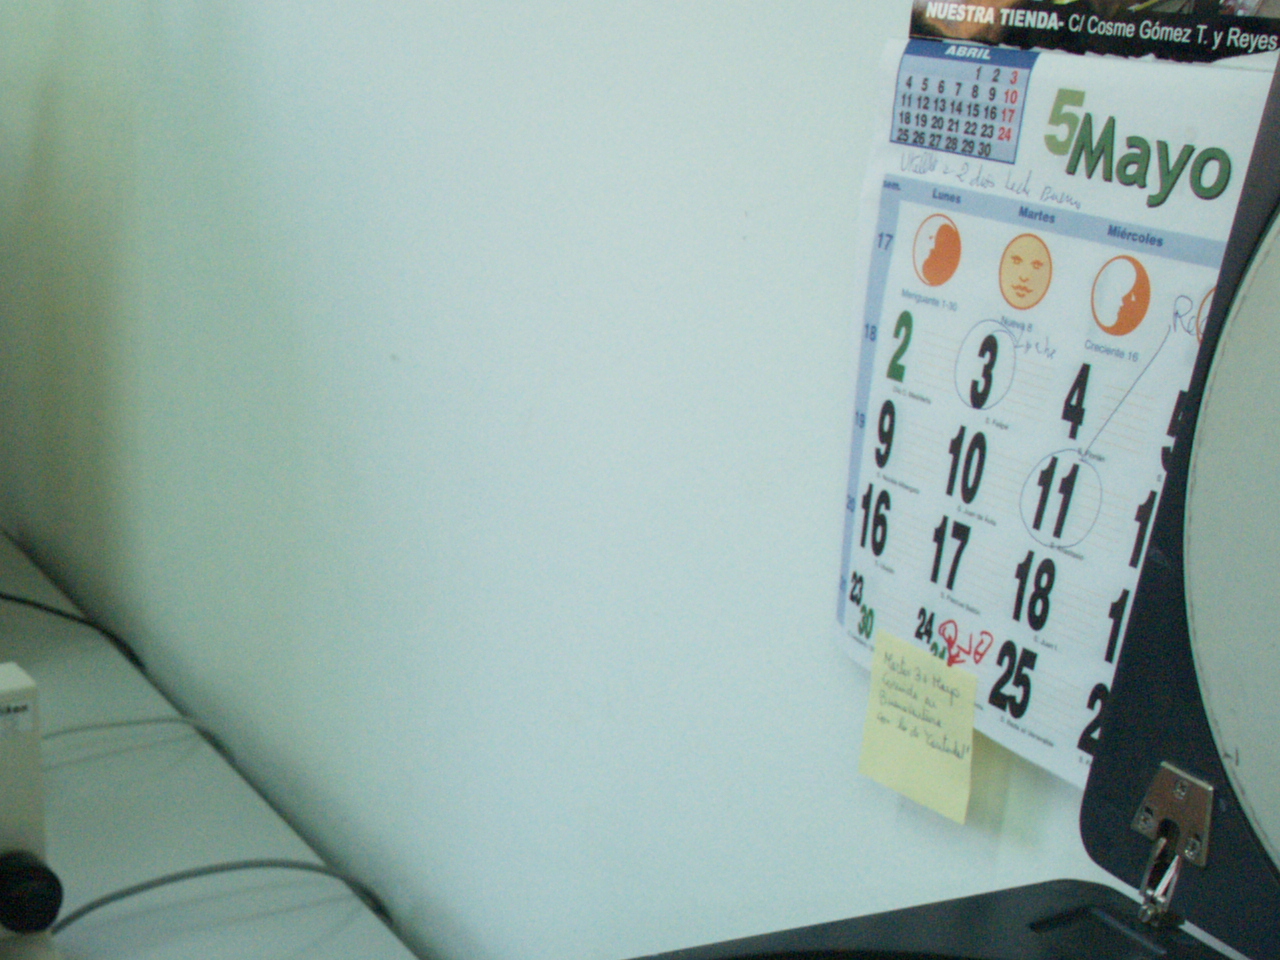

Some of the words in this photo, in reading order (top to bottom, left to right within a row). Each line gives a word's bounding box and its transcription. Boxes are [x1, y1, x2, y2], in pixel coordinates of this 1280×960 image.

[925, 1, 995, 25] NUESTRA
[999, 7, 1065, 31] TIENDA-
[1087, 15, 1136, 38] Cosme
[1139, 18, 1193, 44] Gómez
[1196, 24, 1208, 45] T.
[1211, 30, 1224, 50] y
[1227, 27, 1279, 54] Reyes
[945, 45, 992, 60] ABRIL
[906, 76, 913, 90] 4
[921, 78, 930, 92] 5
[938, 80, 946, 94] 6
[955, 82, 963, 96] 7
[971, 85, 980, 99] 8
[988, 87, 997, 102] 9
[1004, 89, 1018, 105] 10
[976, 66, 983, 81] 1
[992, 68, 1001, 83] 2
[1010, 70, 1019, 85] 3
[901, 93, 913, 107] 11
[917, 95, 931, 110] 12
[933, 98, 947, 113] 13
[950, 100, 963, 115] 14
[967, 103, 980, 117] 15
[983, 105, 998, 120] 16
[1001, 108, 1017, 123] 17
[898, 110, 912, 125] 18
[914, 113, 928, 128] 19
[930, 115, 945, 130] 20
[947, 118, 960, 133] 21
[963, 121, 978, 136] 22
[980, 123, 995, 139] 23
[997, 126, 1012, 141] 24
[896, 128, 910, 143] 25
[912, 131, 926, 145] 26
[929, 133, 943, 148] 27
[945, 136, 959, 151] 28
[961, 138, 976, 154] 29
[978, 141, 992, 157] 30
[1065, 112, 1232, 209] Mayo
[932, 188, 962, 204] Lunes
[1018, 206, 1056, 224] Martes
[1107, 224, 1164, 248] Miércoles
[877, 232, 893, 250] 17
[864, 323, 877, 342] 18
[886, 310, 913, 383] 2
[970, 334, 998, 410] 3
[1061, 362, 1091, 440] 4
[874, 400, 896, 469] 9
[946, 424, 987, 504] 10
[1032, 455, 1080, 539] 11
[1129, 489, 1158, 569] 1
[860, 482, 891, 557] 16
[930, 515, 971, 591] 17
[1013, 550, 1056, 631] 18
[1105, 588, 1130, 664] 1
[858, 604, 875, 639] 30
[849, 571, 864, 606] 23
[915, 607, 935, 645] 24
[989, 640, 1038, 719] 25
[1077, 683, 1111, 757] 2
